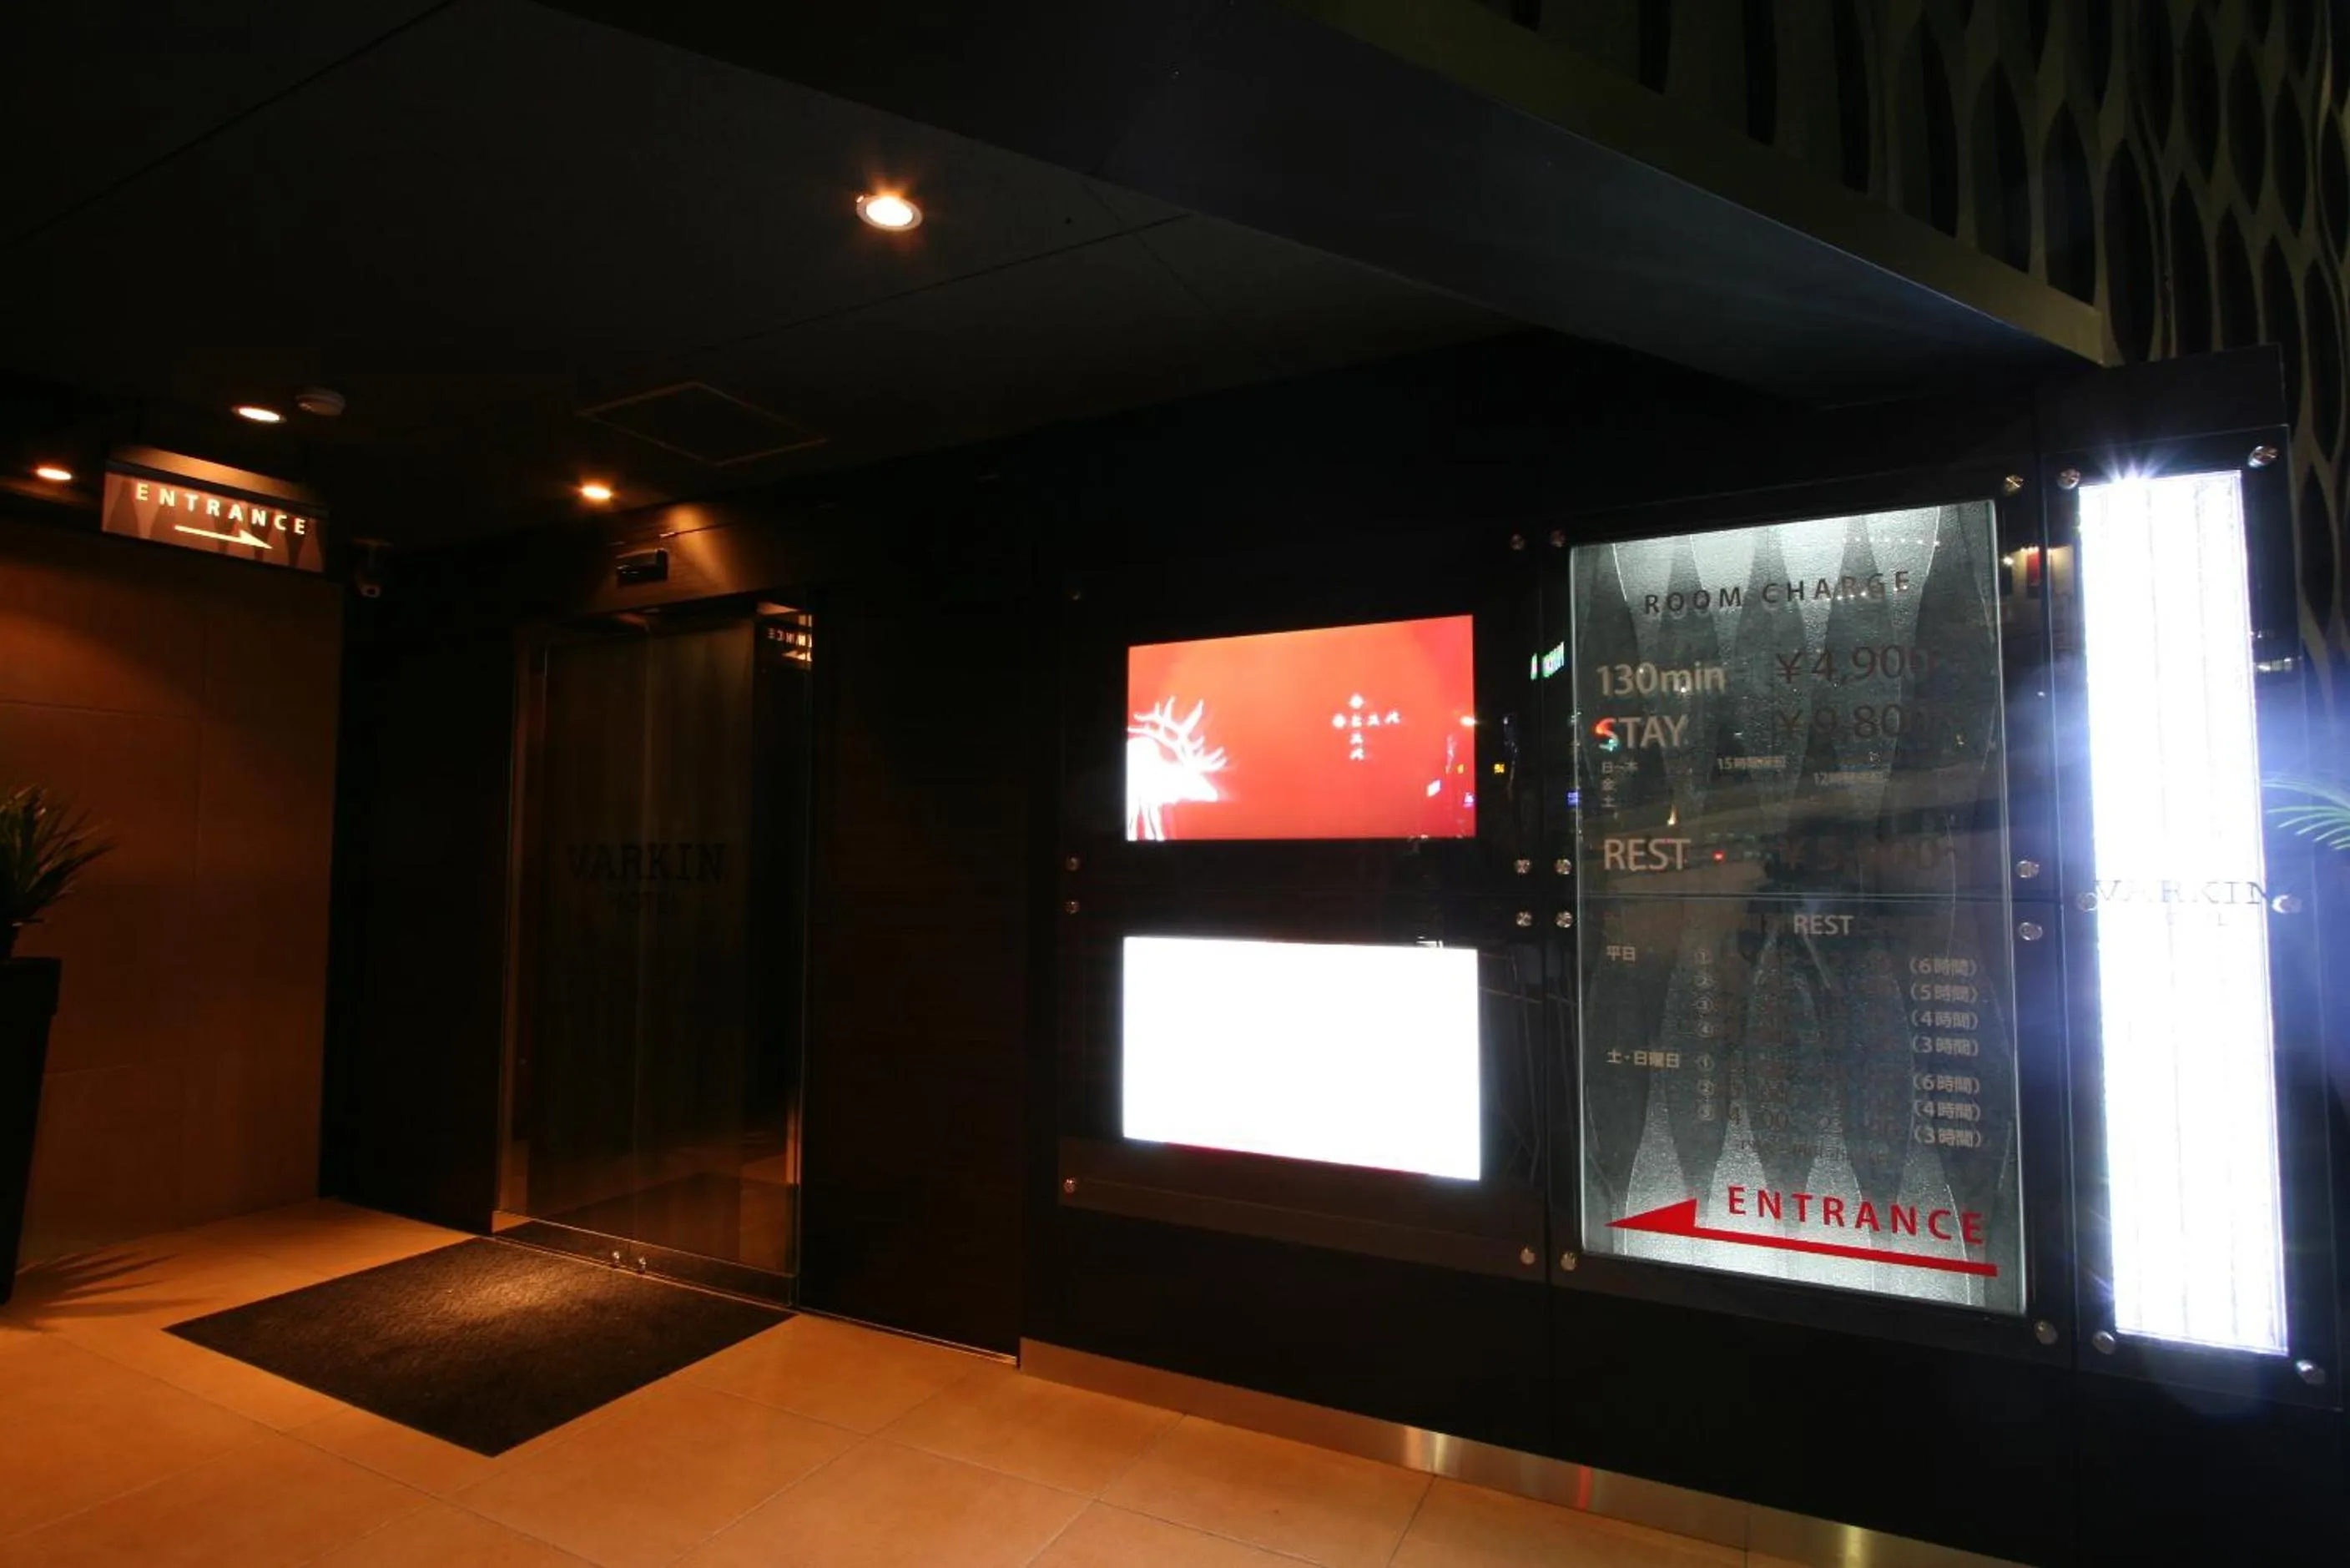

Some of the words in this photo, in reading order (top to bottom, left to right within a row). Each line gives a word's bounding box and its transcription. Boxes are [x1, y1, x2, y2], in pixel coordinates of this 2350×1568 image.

[135, 482, 306, 535] ENTRANCE
[1644, 586, 1742, 615] ROOM
[1762, 570, 1910, 604] CHARGE
[1596, 661, 1726, 697] 130min
[1593, 714, 1688, 751] STAY
[566, 842, 726, 883] VARKIN
[1603, 838, 1692, 872] REST
[1793, 914, 1854, 936] REST
[1606, 945, 1636, 961] 平日
[1909, 957, 1977, 977] (6時間)
[1910, 982, 1979, 1003] (5時間)
[1911, 1009, 1979, 1031] (4時間)
[1912, 1036, 1979, 1056] (3時間)
[1913, 1074, 1980, 1095] (6時間)
[1913, 1099, 1982, 1122] (4時間)
[1914, 1127, 1983, 1148] (3時間)
[1728, 1185, 1984, 1245] ENTRANCE
